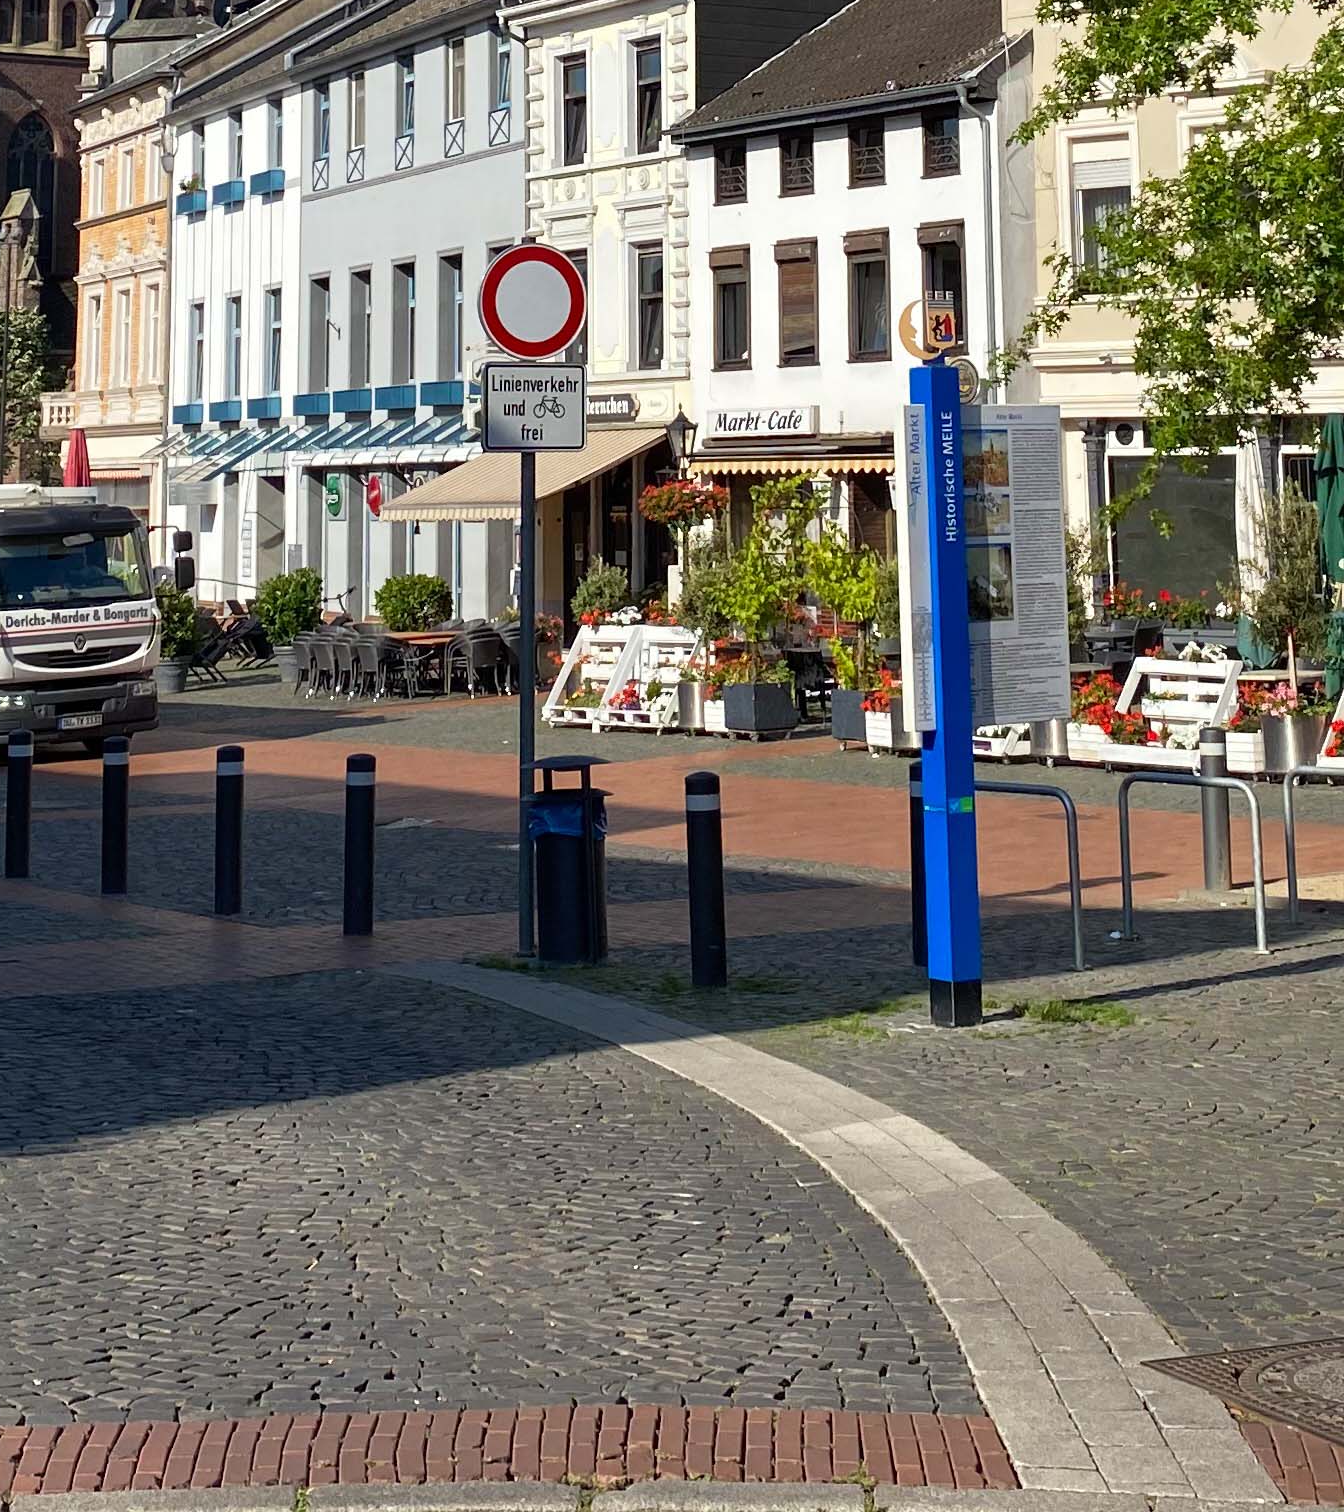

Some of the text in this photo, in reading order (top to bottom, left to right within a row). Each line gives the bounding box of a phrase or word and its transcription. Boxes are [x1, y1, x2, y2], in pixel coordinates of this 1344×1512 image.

[491, 375, 579, 392] Linienverkehr
[503, 399, 526, 416] und
[586, 396, 629, 415] ternchen
[521, 424, 544, 441] frei
[909, 413, 922, 496] Alter Markt
[940, 411, 957, 543] Historische MEILE
[5, 606, 149, 629] Derichs-Marder & Bongartz
